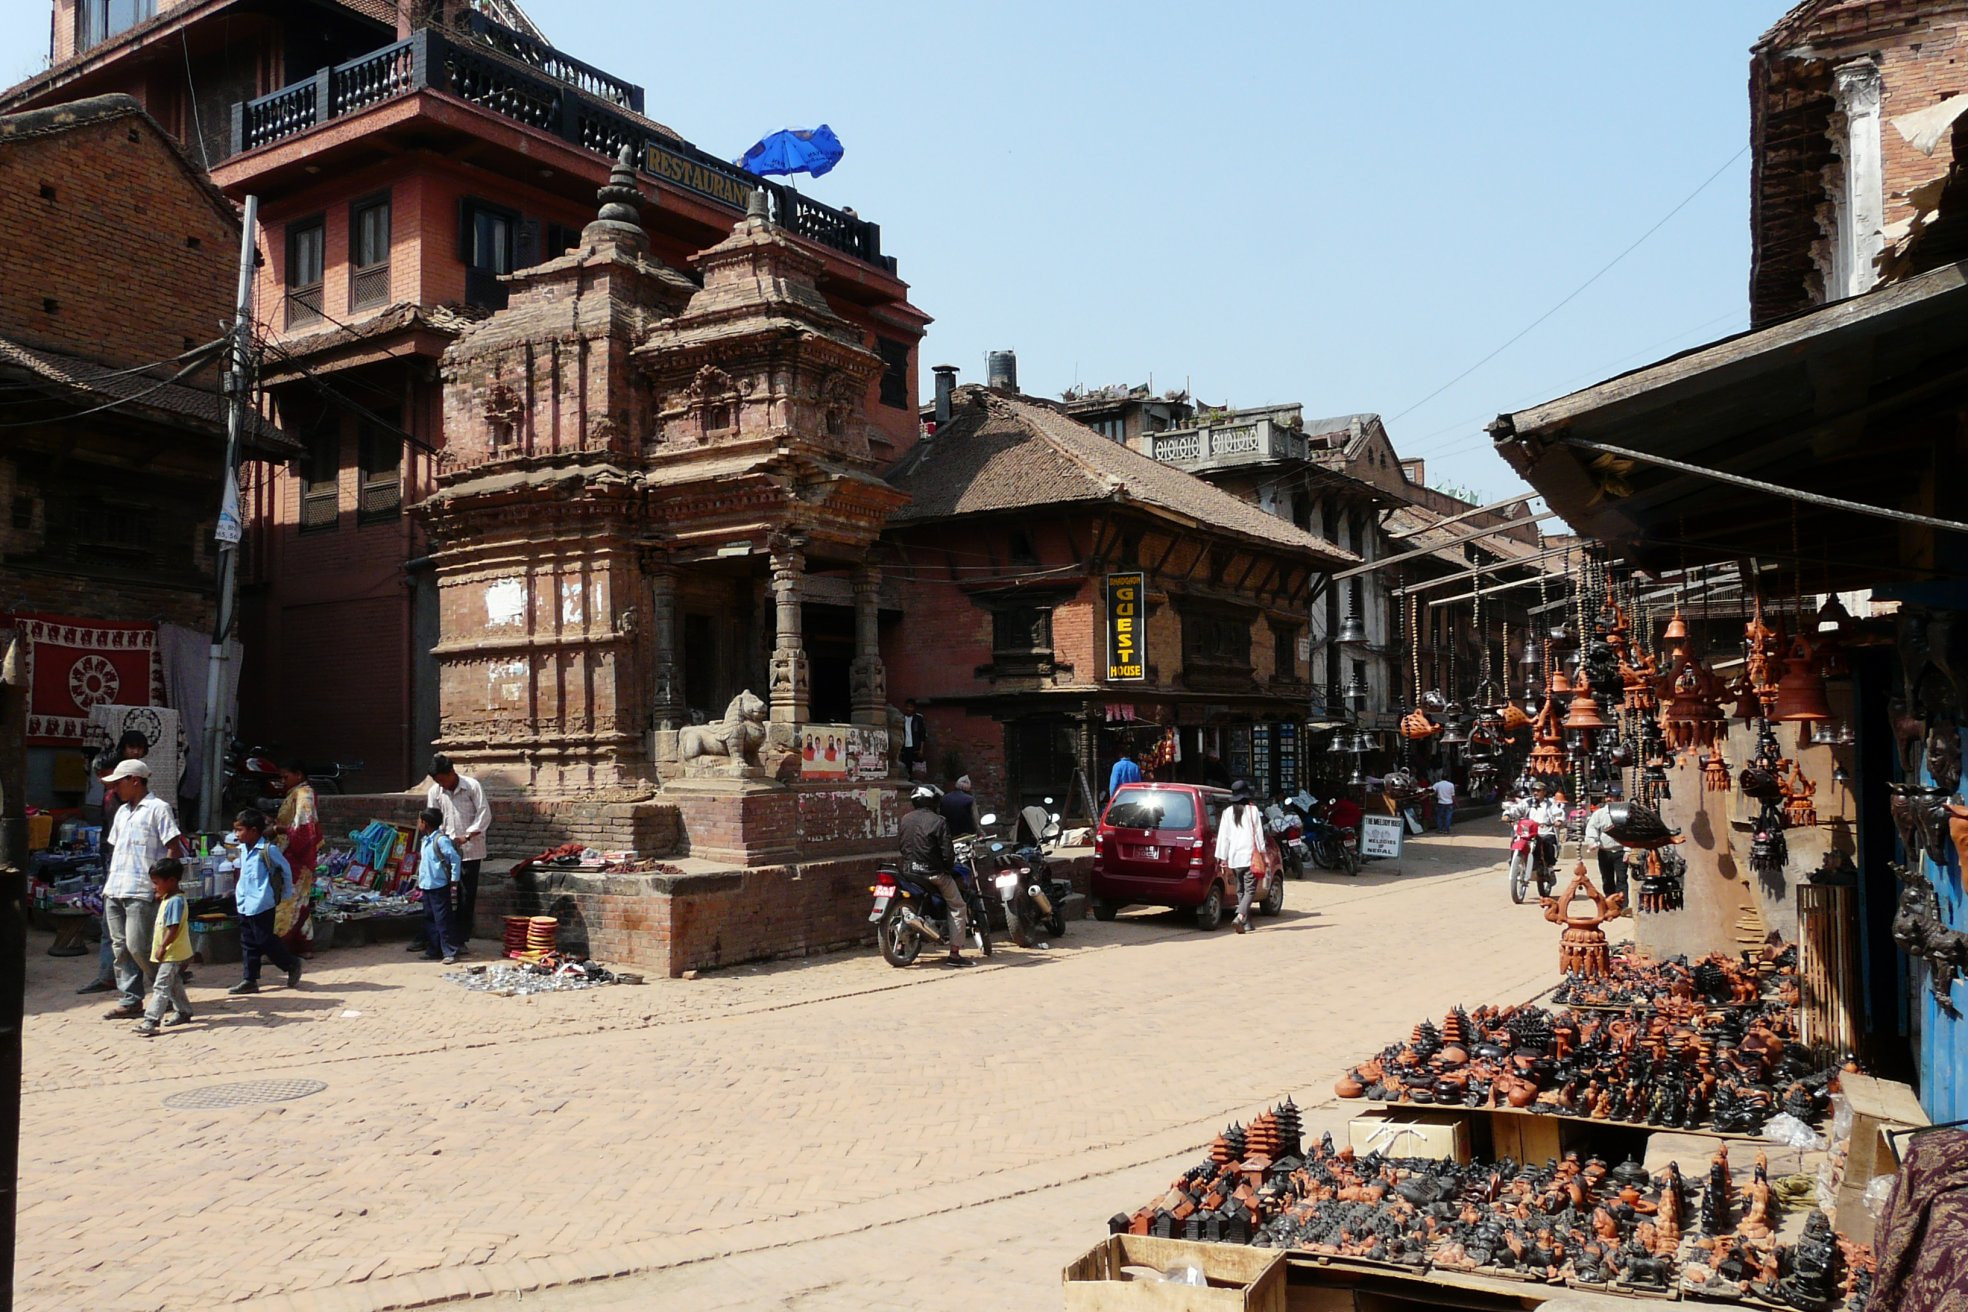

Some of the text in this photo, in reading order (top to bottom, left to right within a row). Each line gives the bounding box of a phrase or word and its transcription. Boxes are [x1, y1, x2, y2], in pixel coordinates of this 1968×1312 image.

[649, 147, 751, 208] RESTAURANT
[1116, 588, 1134, 662] GUEST
[1110, 665, 1141, 677] HOUSE
